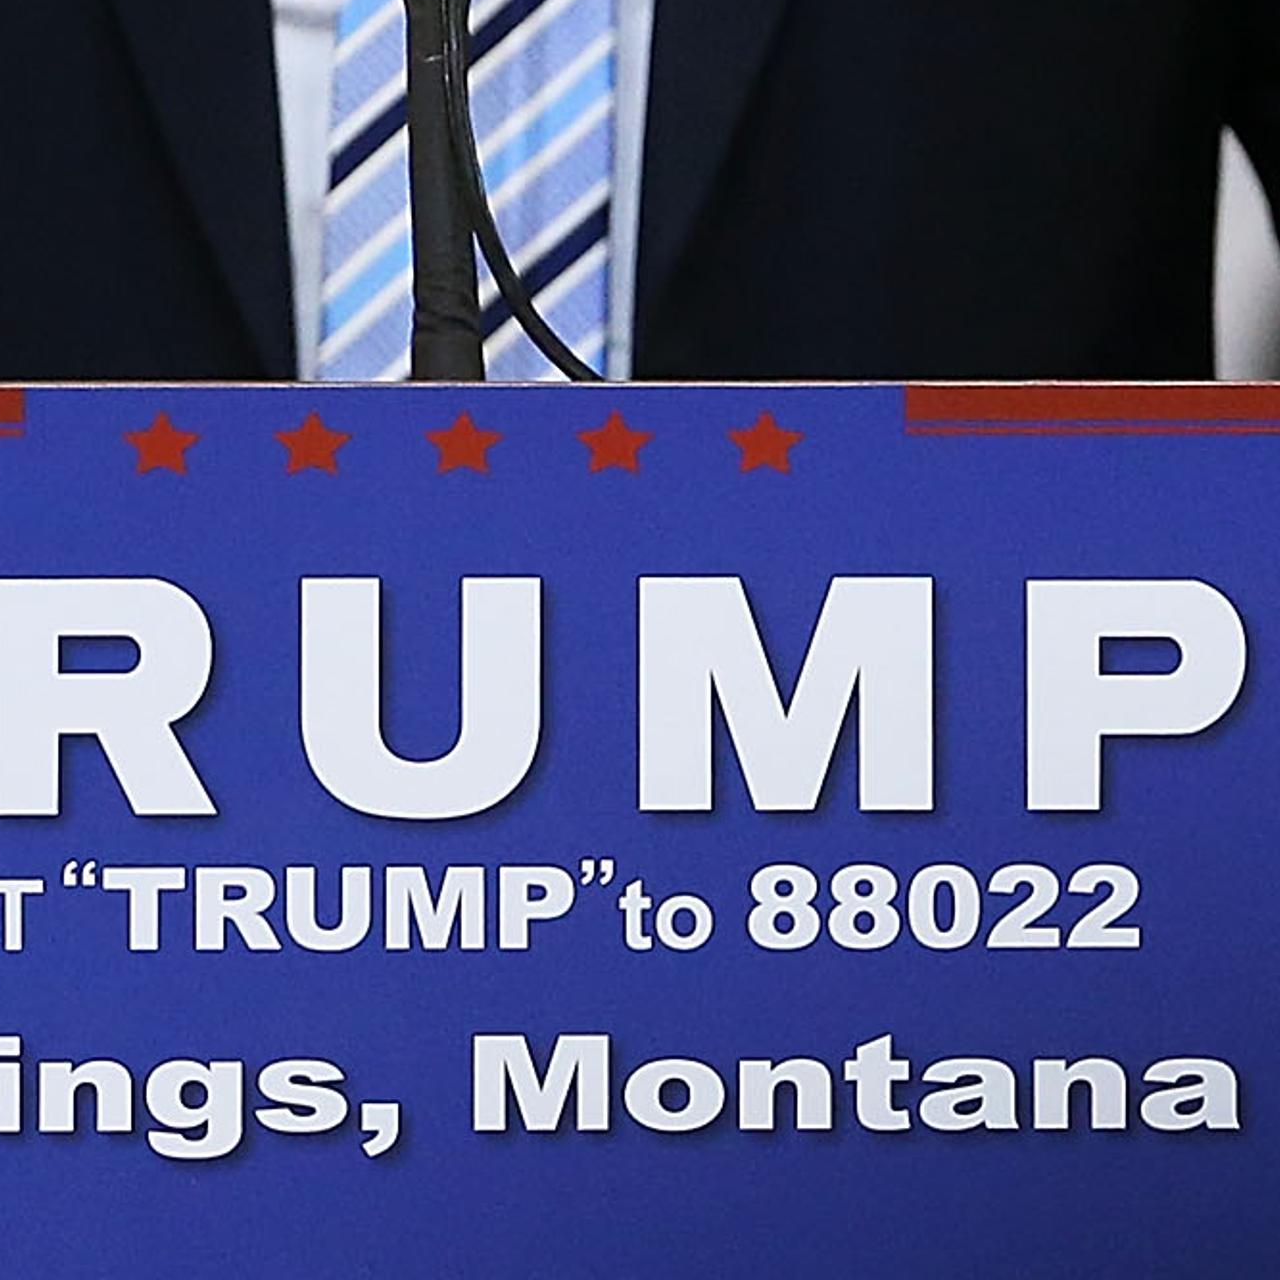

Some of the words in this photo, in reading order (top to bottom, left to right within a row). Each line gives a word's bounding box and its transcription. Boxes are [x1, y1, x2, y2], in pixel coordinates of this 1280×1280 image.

[618, 879, 713, 950] to
[748, 864, 1140, 950] 88022
[473, 1034, 1240, 1132] Montana
